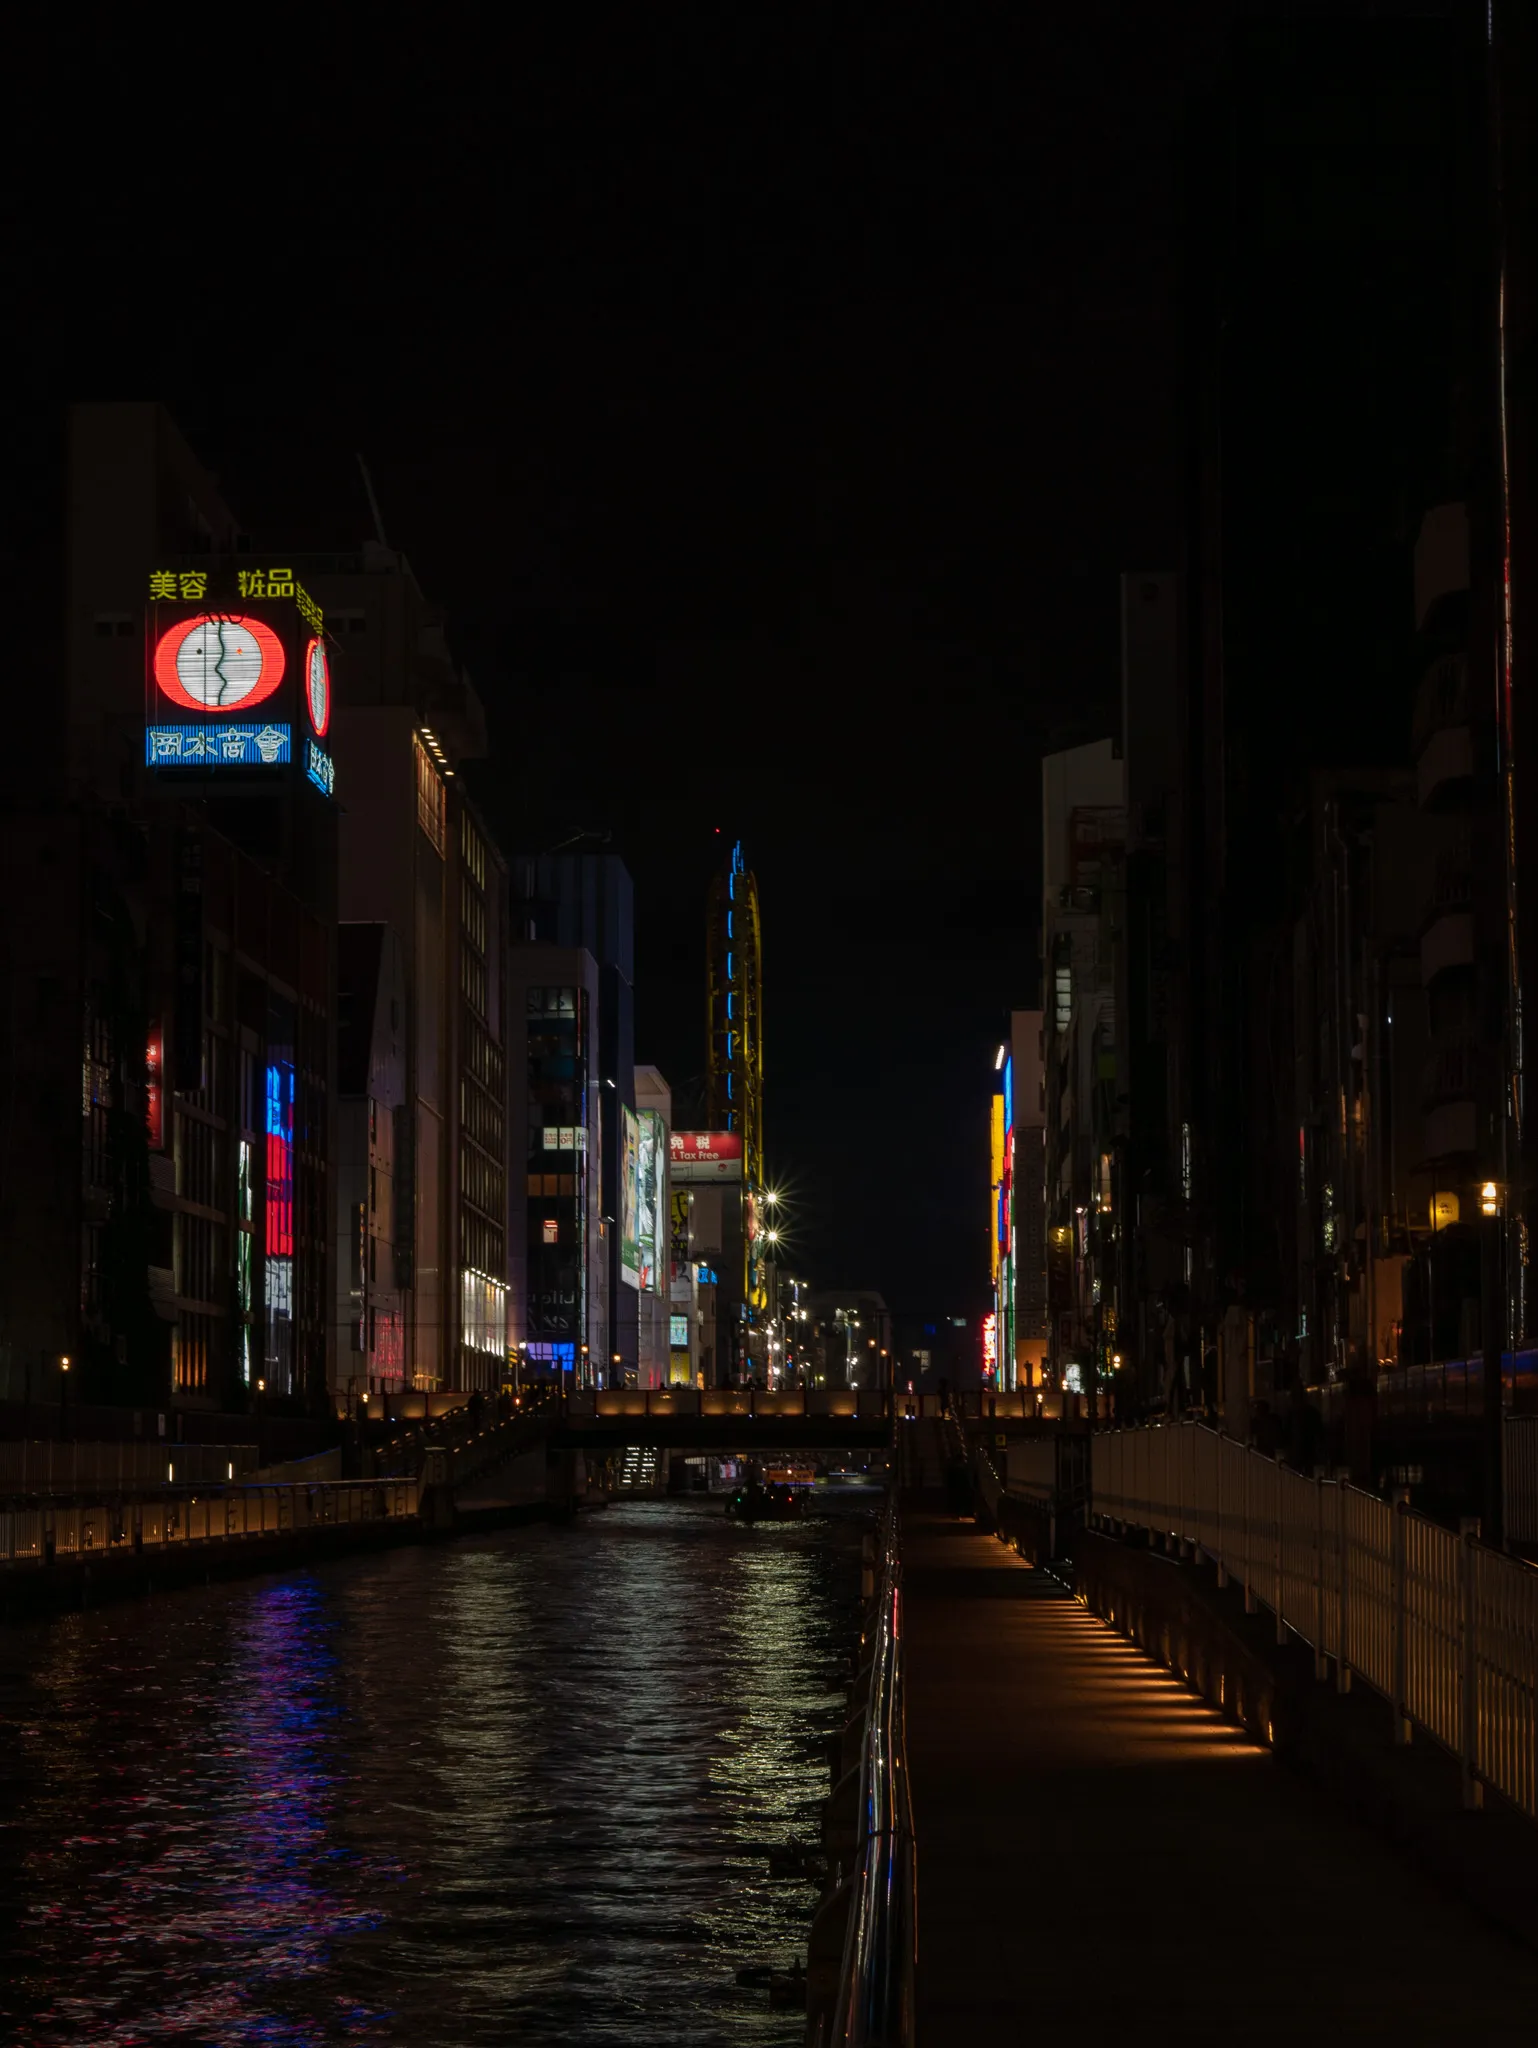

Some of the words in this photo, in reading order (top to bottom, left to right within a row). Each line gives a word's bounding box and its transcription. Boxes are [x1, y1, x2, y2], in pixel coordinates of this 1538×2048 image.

[149, 570, 208, 600] 美容
[237, 568, 295, 598] 粧品
[680, 1151, 697, 1160] Tax
[698, 1150, 720, 1160] Free
